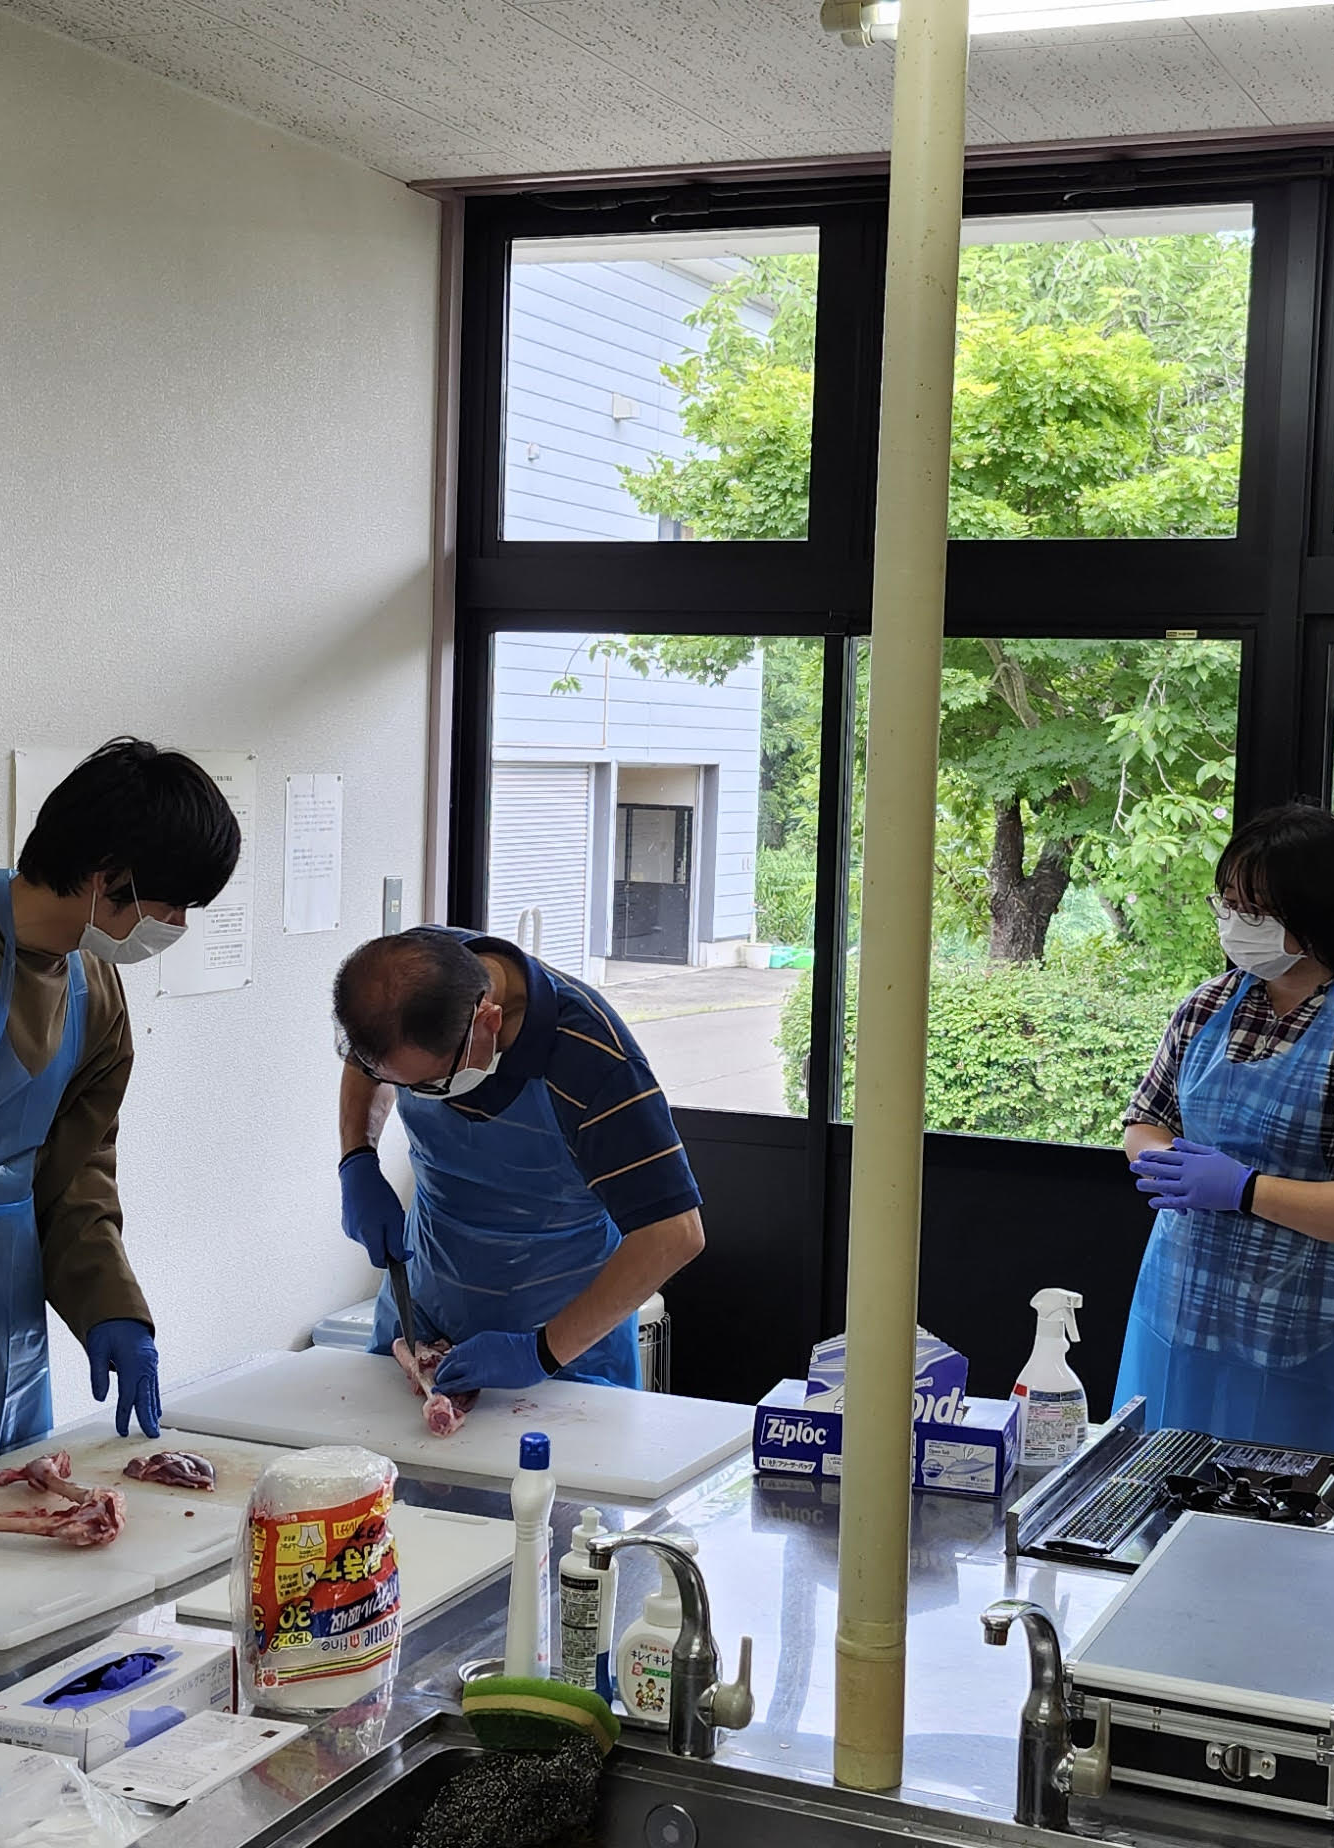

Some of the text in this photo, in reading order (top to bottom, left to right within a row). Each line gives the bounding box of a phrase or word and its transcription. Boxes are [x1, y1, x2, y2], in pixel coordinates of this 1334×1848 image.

[767, 1418, 827, 1447] Ziploc
[630, 1650, 672, 1666] キレイキレ
